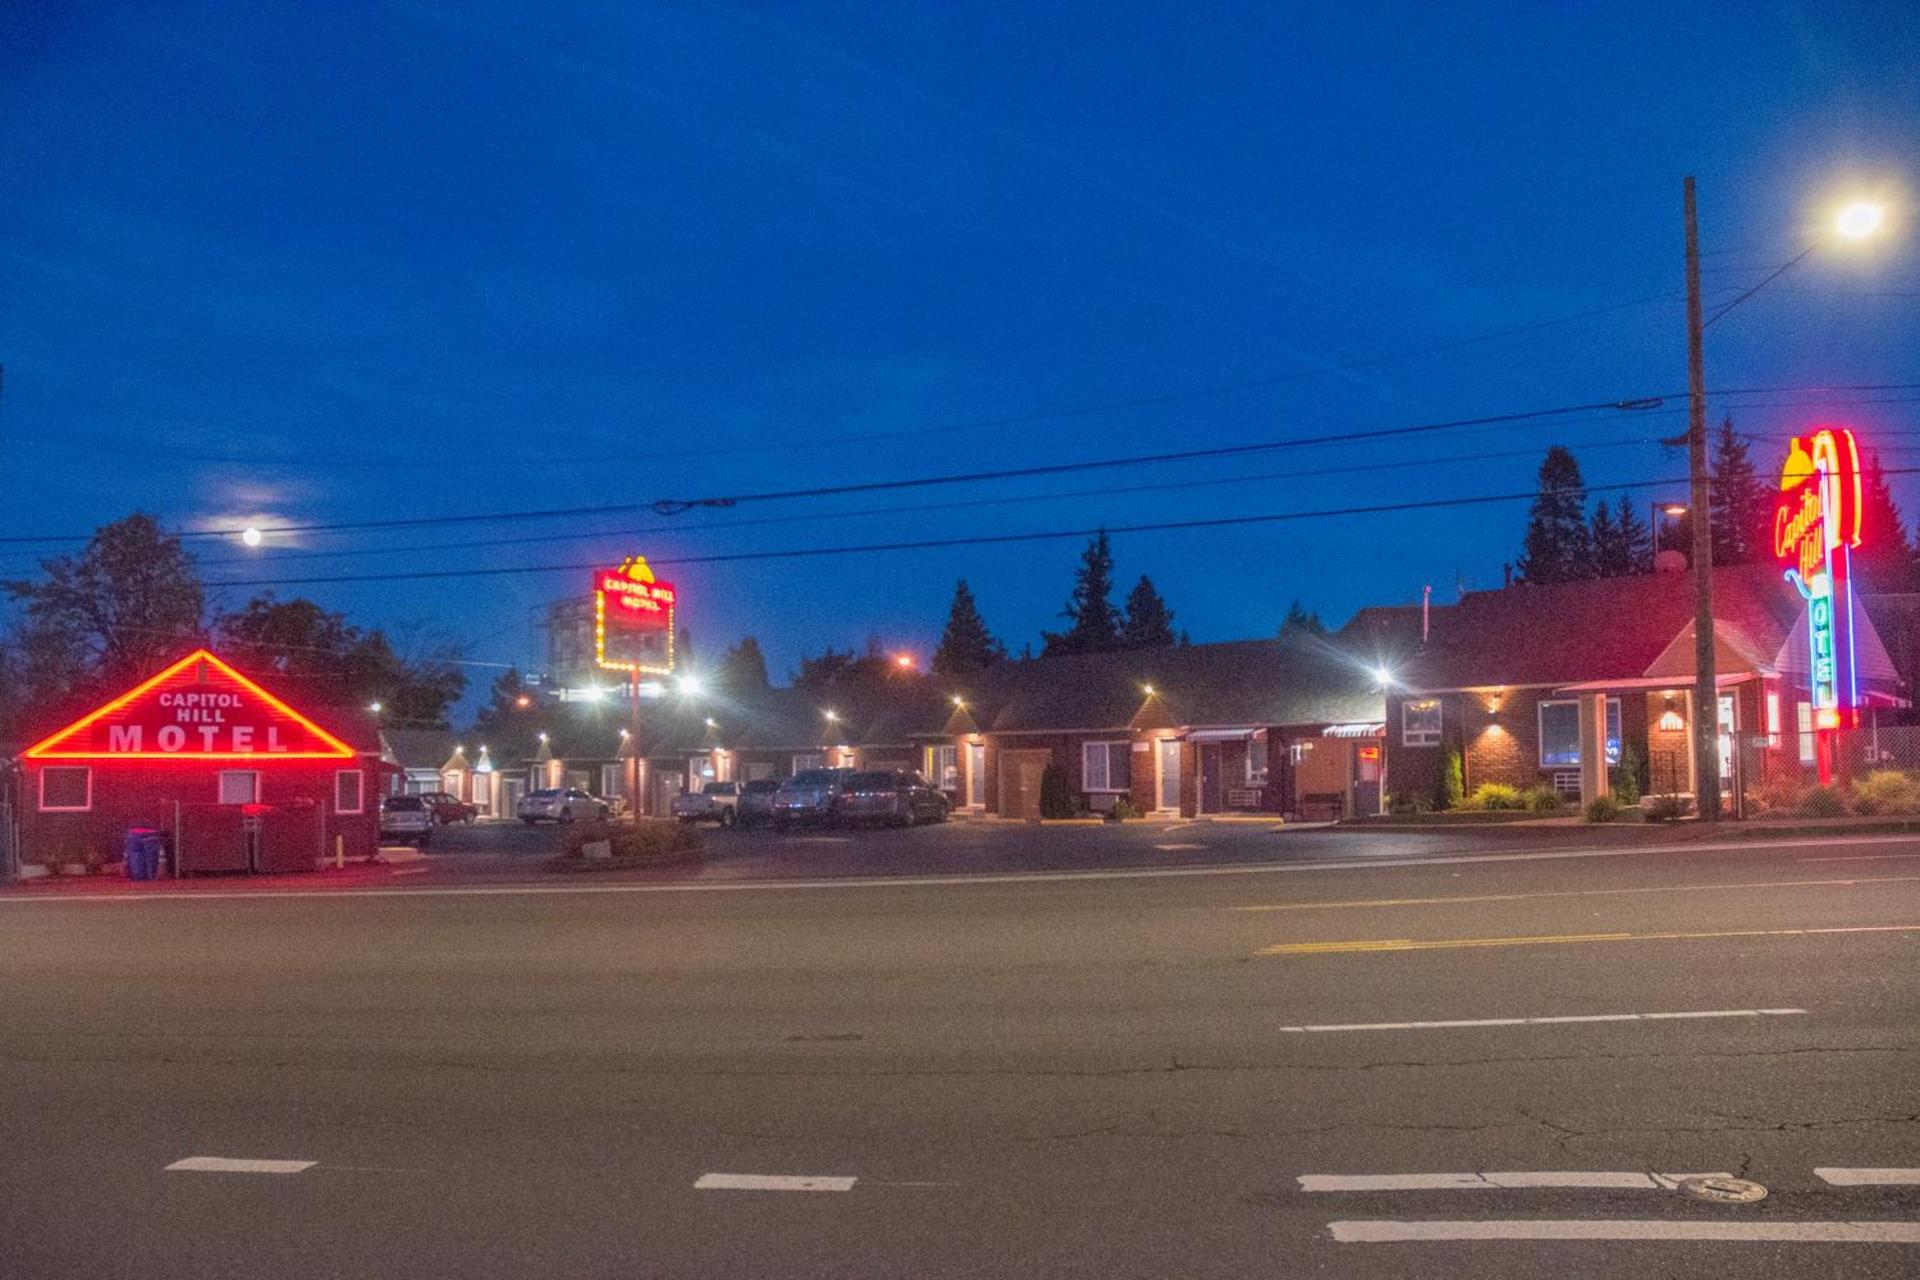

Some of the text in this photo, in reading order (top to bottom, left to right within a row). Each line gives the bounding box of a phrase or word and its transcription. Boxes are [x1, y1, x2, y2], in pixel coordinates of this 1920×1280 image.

[1775, 480, 1824, 558] Capitol
[1800, 521, 1824, 584] Hill
[604, 577, 650, 597] CAPITOL
[159, 693, 243, 707] CAPITOL
[176, 709, 226, 722] HILL
[109, 725, 288, 752] MOTEL
